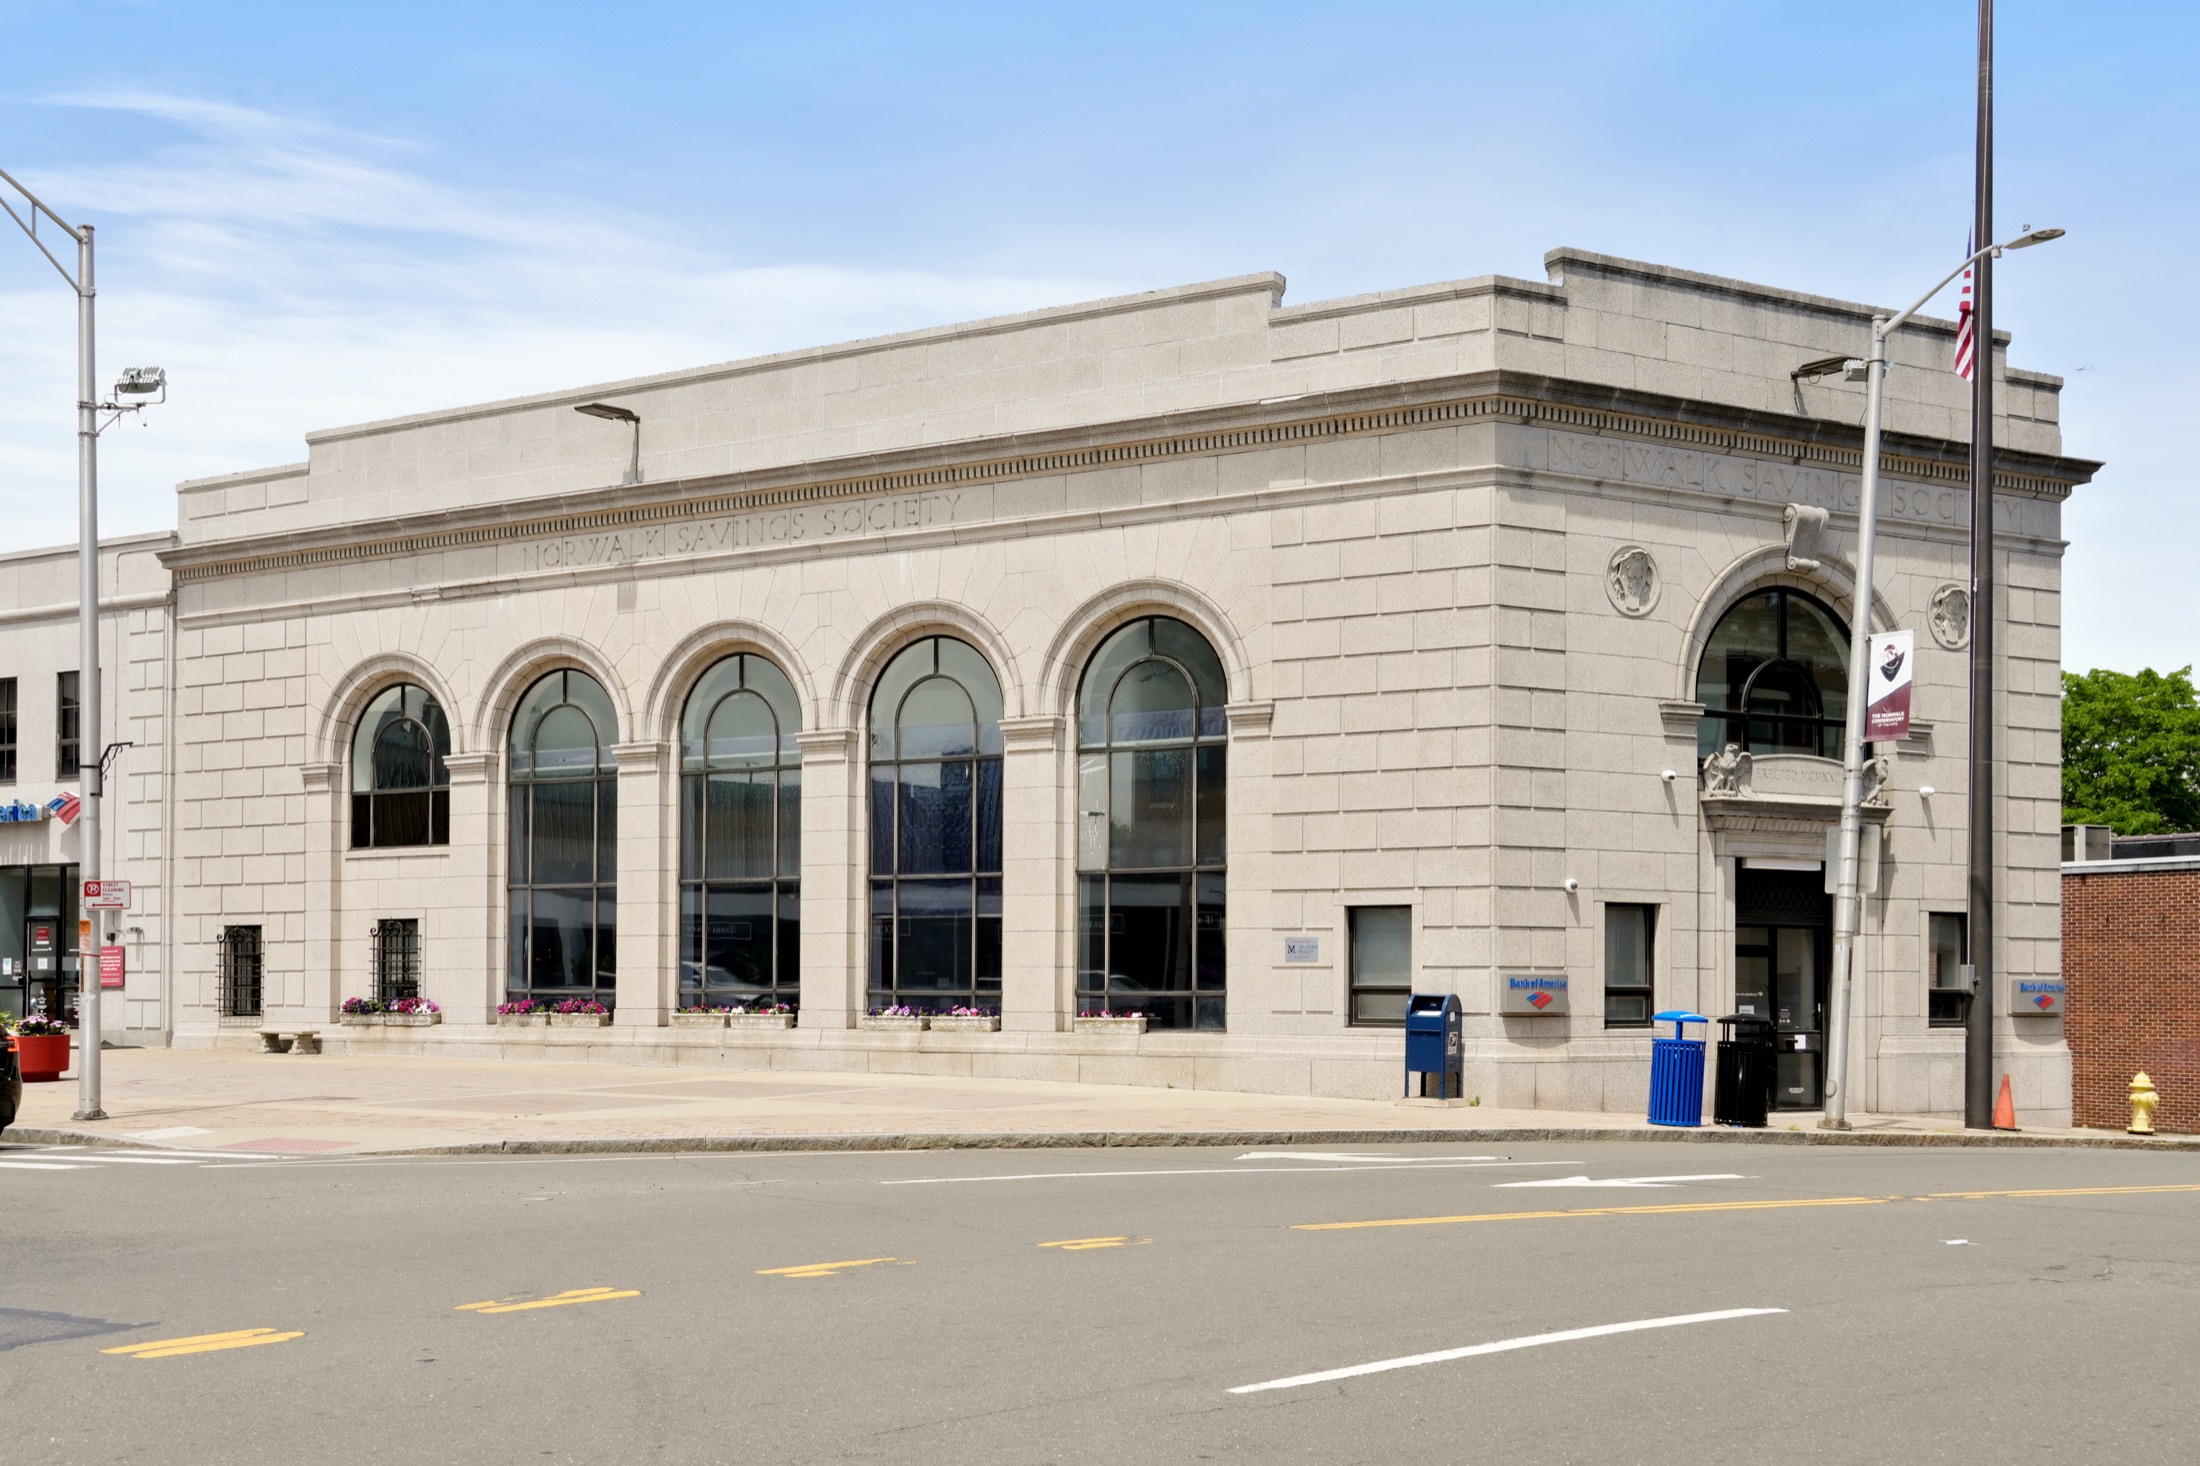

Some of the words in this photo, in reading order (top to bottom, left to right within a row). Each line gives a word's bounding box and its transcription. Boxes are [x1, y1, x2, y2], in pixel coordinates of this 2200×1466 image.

[1552, 435, 1727, 490] NORWALK
[1742, 464, 1861, 507] SAVING
[1894, 486, 2021, 521] SOCIY
[522, 530, 663, 571] NORWALK
[678, 513, 804, 553] SAVINGS
[823, 494, 961, 536] SOCIETY
[1757, 768, 1797, 781] ERECTED
[1510, 978, 1529, 988] Bank
[1531, 978, 1538, 988] of
[1539, 978, 1567, 989] America
[2020, 983, 2036, 991] Bank
[2043, 983, 2065, 991] America
